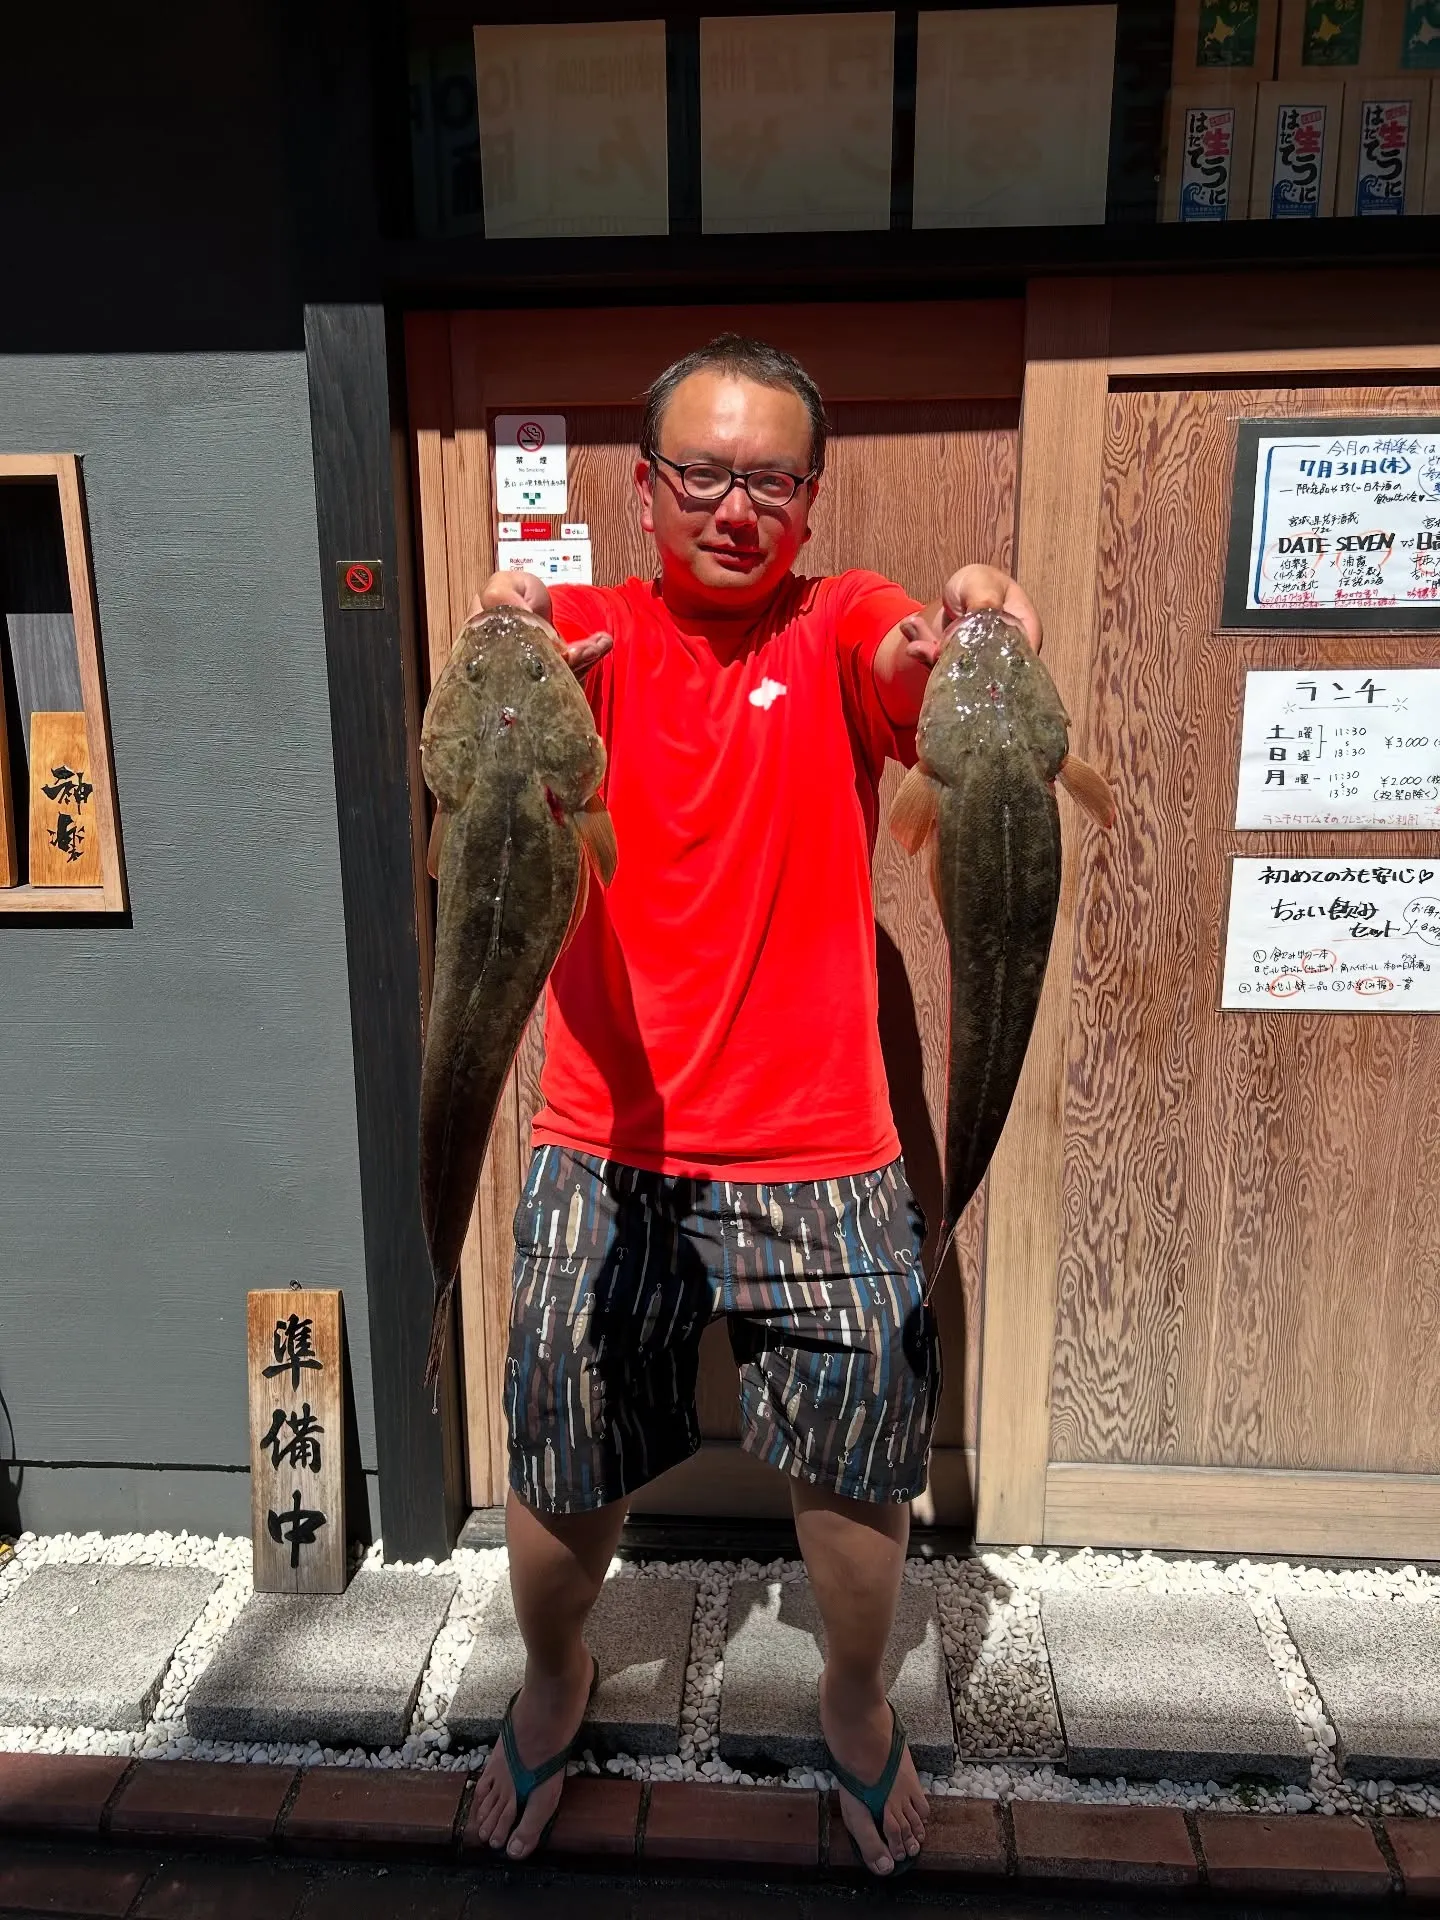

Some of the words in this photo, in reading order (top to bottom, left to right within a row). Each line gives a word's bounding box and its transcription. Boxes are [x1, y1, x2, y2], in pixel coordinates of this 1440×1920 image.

[1278, 536, 1331, 555] DATE
[1335, 531, 1396, 551] SEVEN
[1295, 678, 1387, 704] ランチ
[1266, 724, 1313, 740] 土曜
[1334, 727, 1367, 737] 11:30
[1269, 747, 1311, 762] 日曜
[1334, 747, 1366, 758] 13:30
[1264, 769, 1310, 786] 月曜
[1329, 770, 1360, 782] 11:30
[1329, 787, 1359, 799] 13:30
[1270, 896, 1380, 922] ちょい飲み
[1349, 920, 1401, 938] セット
[259, 1313, 327, 1569] 準備中
